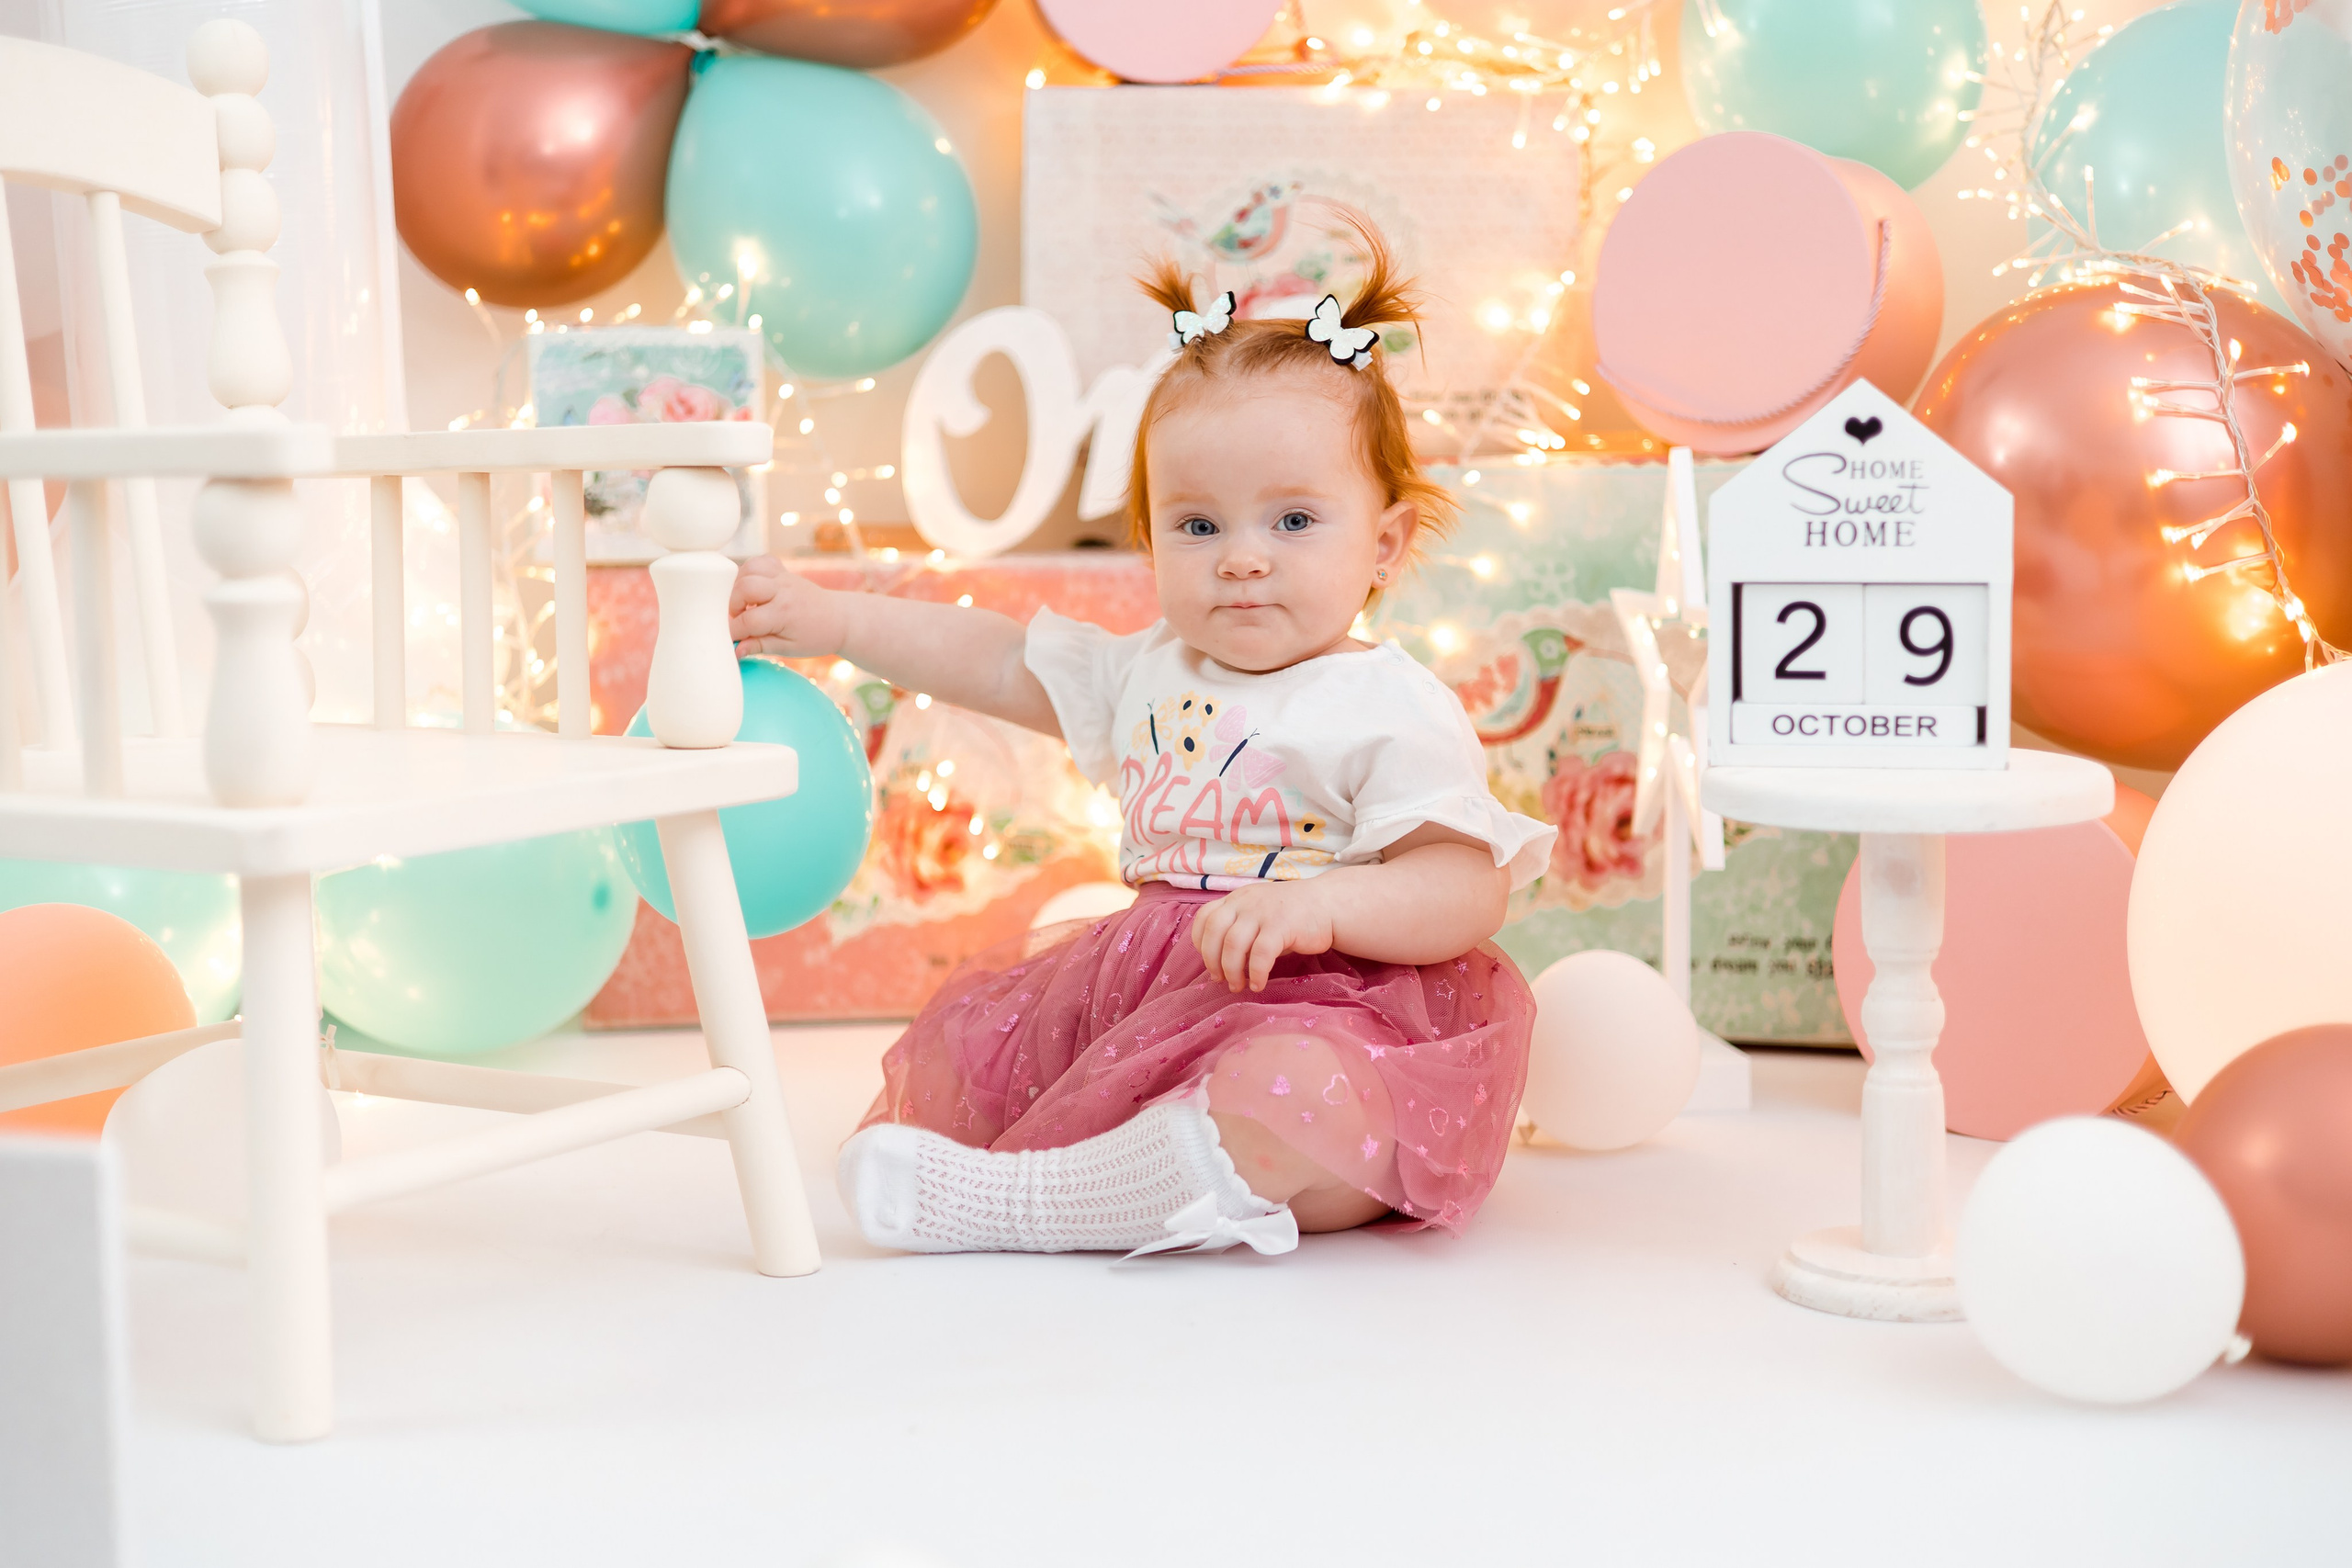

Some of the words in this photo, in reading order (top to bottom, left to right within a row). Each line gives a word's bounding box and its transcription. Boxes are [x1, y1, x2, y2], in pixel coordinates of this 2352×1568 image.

[1849, 460, 1925, 480] HOME
[1782, 452, 1929, 516] Sweet
[1804, 520, 1916, 547] HOME
[1772, 714, 1938, 737] OCTOBER
[1121, 751, 1293, 847] DREAM
